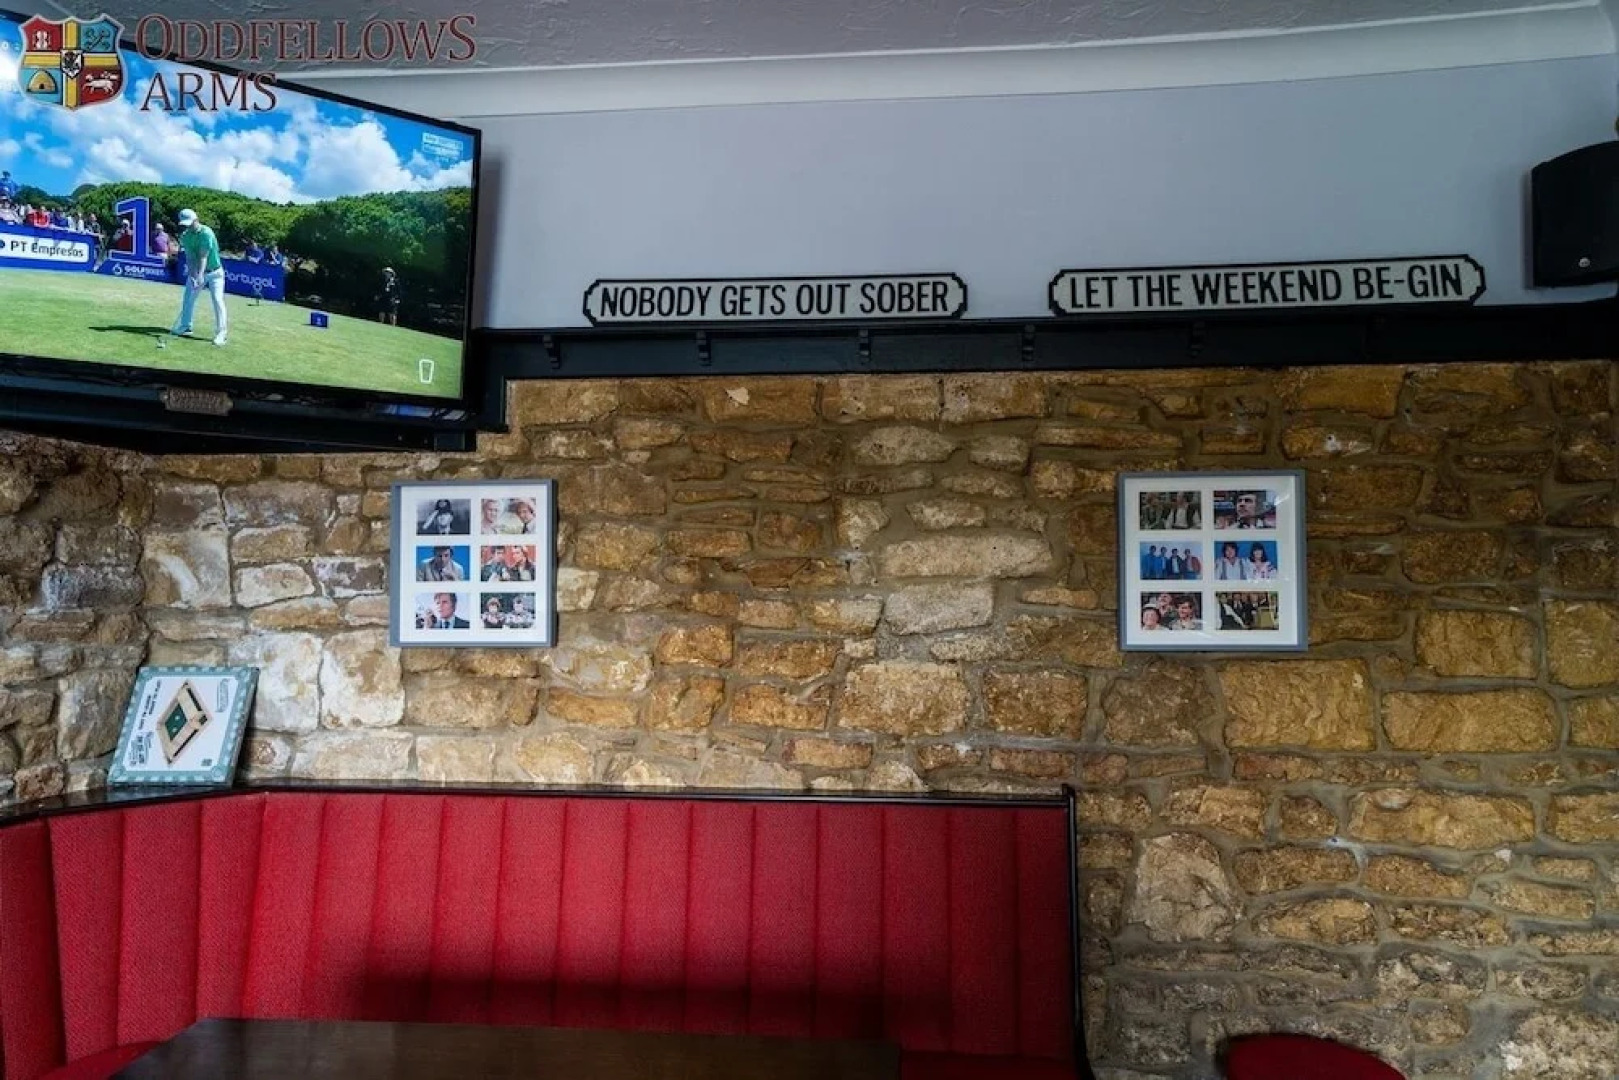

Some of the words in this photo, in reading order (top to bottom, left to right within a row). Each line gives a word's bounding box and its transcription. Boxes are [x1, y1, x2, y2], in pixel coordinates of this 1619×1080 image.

[11, 240, 28, 252] PT
[31, 242, 84, 257] Empresas
[600, 286, 711, 317] NOBODY
[720, 284, 786, 315] GETS
[796, 283, 851, 315] OUT
[859, 280, 949, 313] SOBER
[1069, 276, 1118, 309] LET
[1127, 274, 1183, 306] THE
[1191, 268, 1342, 305] WEEKEND
[1352, 262, 1463, 300] BE-GIN
